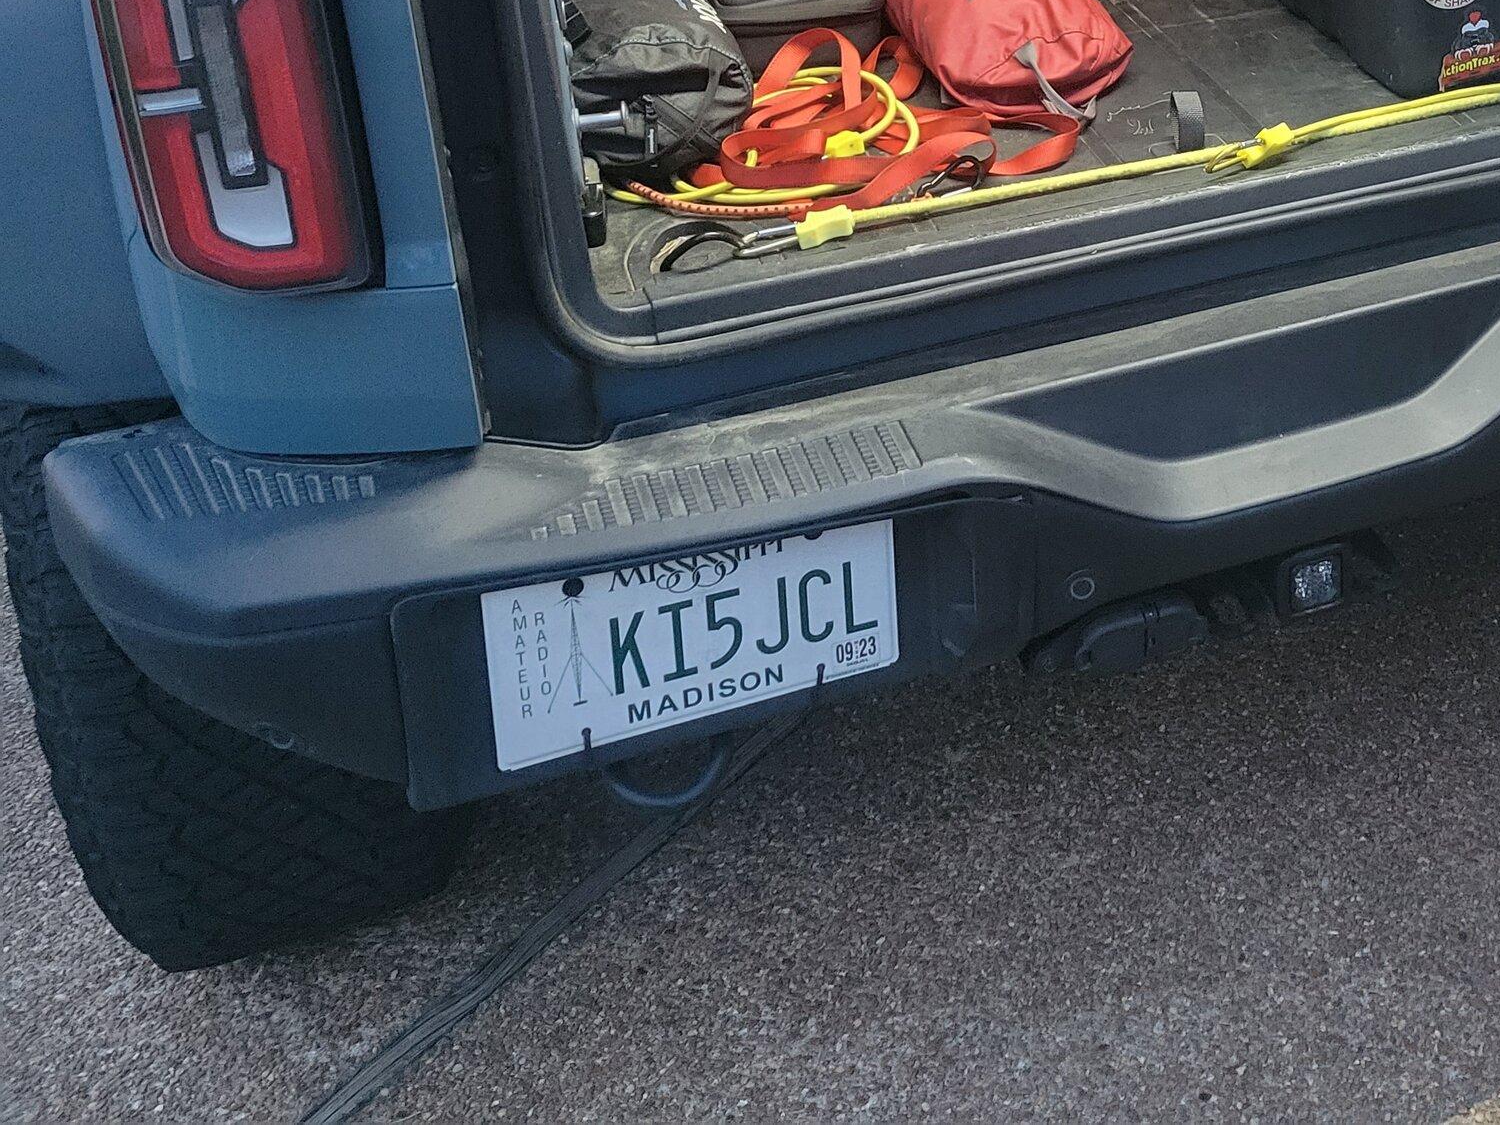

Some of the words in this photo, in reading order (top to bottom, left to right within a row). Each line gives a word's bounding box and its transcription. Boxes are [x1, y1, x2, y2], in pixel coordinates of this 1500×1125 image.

[511, 599, 533, 719] AMATEUR
[534, 611, 552, 695] RADIO
[608, 561, 879, 696] KI5JCL
[836, 642, 853, 663] 09
[859, 636, 876, 658] 23
[627, 664, 784, 724] MADISON
